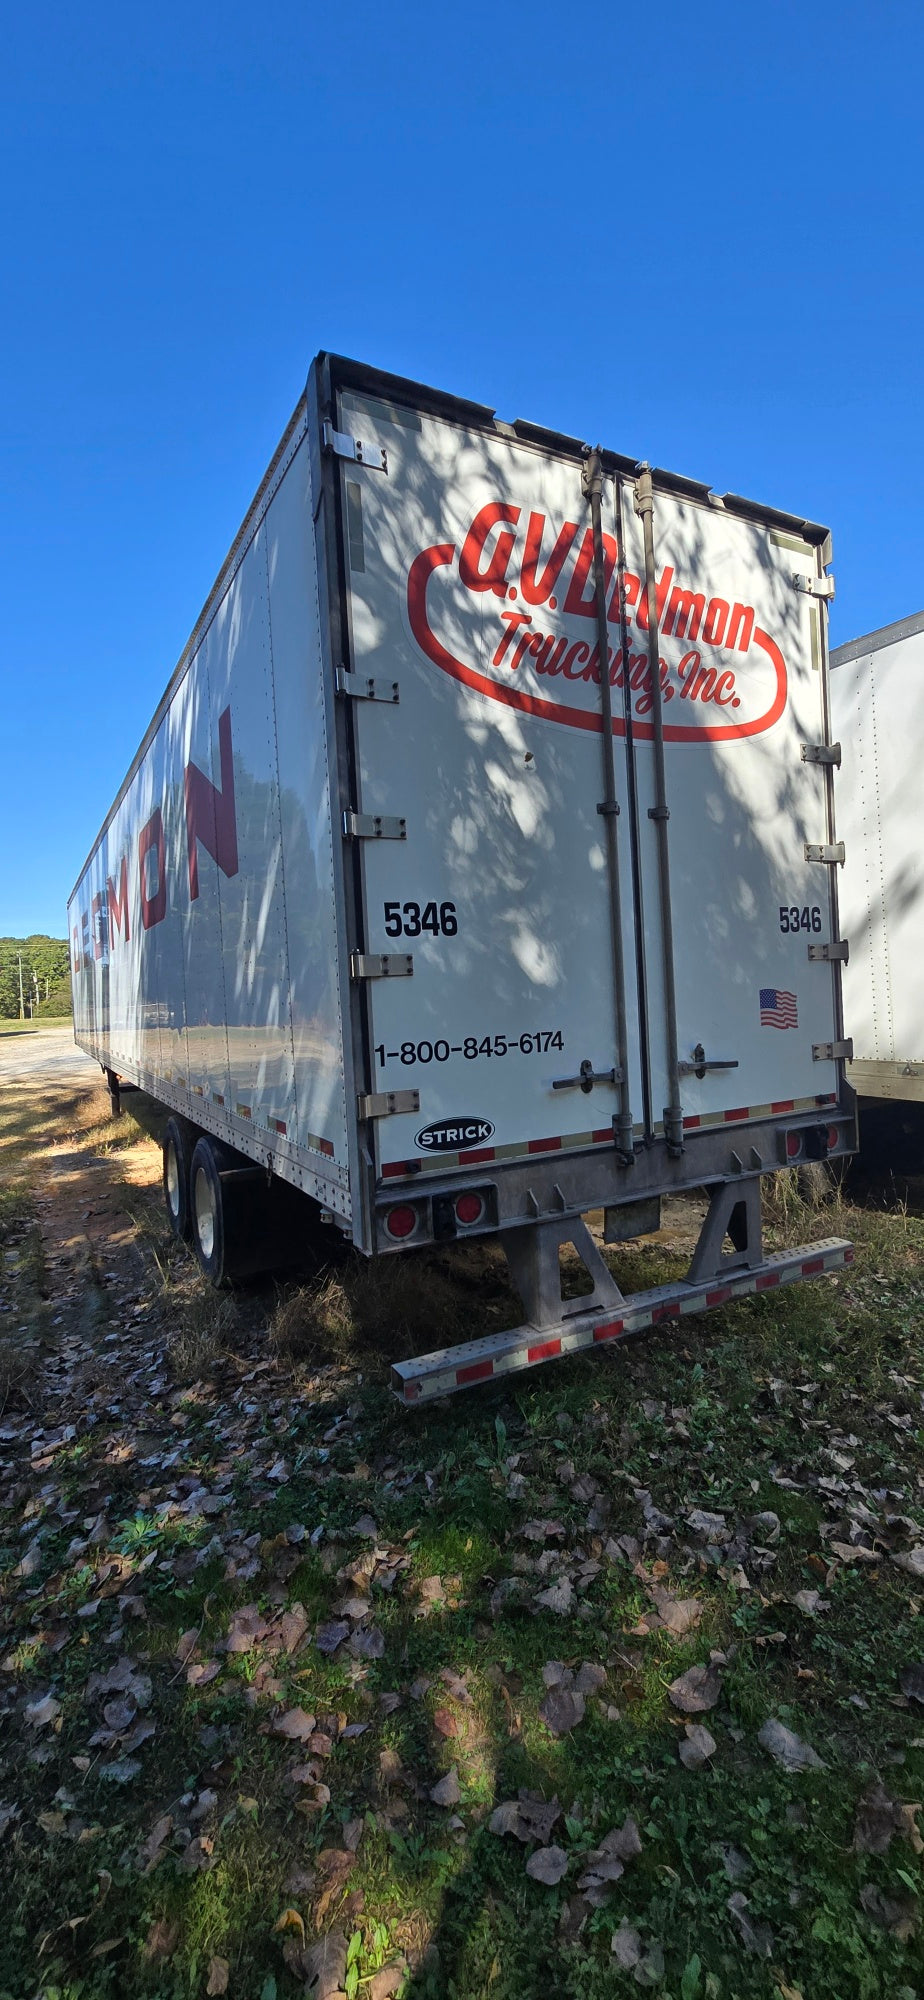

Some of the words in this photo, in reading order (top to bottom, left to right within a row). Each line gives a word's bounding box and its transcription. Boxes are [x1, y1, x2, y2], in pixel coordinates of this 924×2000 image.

[492, 611, 675, 715] Trucking,
[677, 650, 741, 708] Inc.
[383, 901, 458, 937] 5346
[779, 906, 822, 933] 5346
[374, 1030, 565, 1067] 1-800-845-6174
[421, 1123, 489, 1145] STRICK
